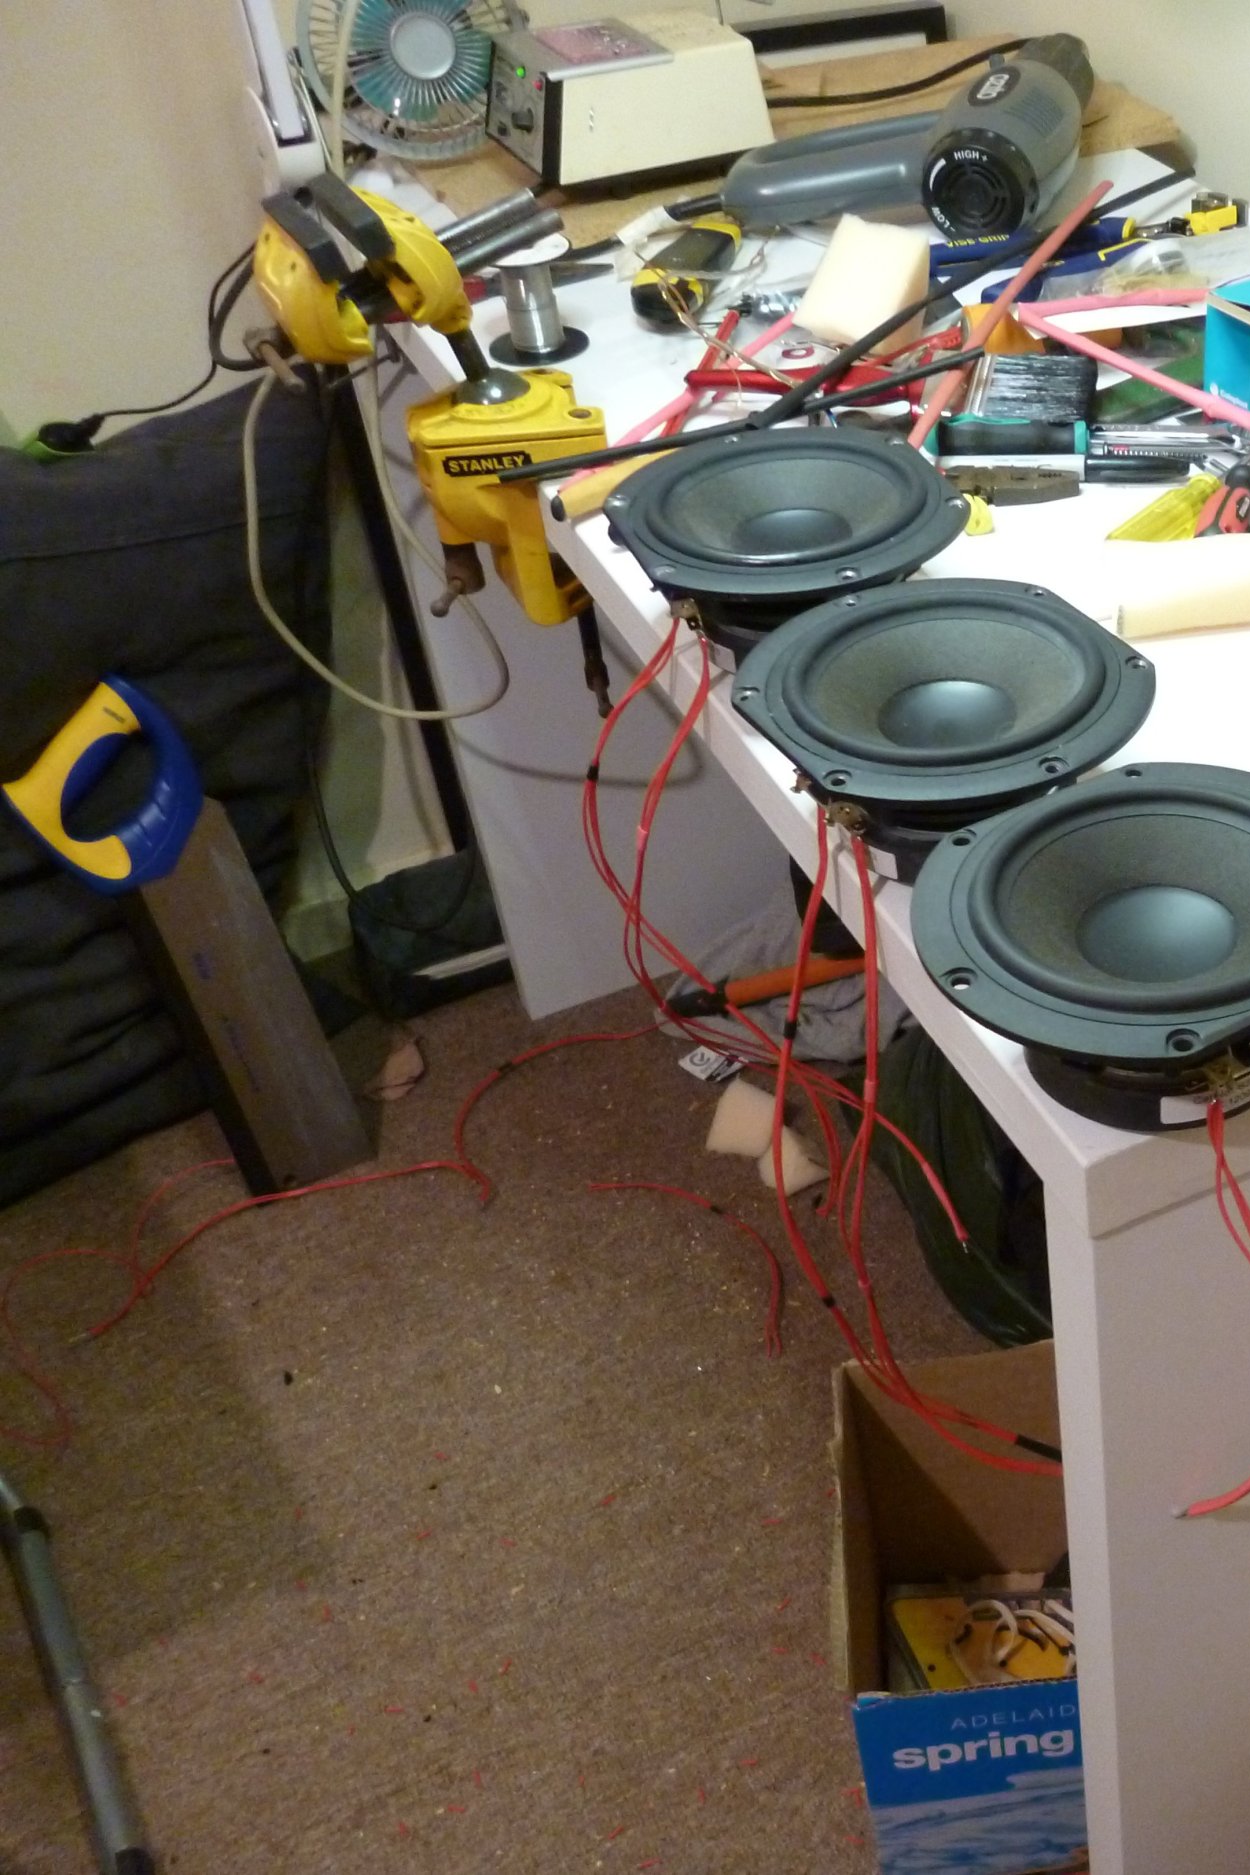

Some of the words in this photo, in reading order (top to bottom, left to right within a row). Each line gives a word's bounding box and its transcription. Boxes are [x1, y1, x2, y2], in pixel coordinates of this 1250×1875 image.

[953, 149, 980, 161] HIGH
[931, 206, 951, 229] LOW
[448, 455, 524, 473] STANLEY
[951, 1703, 1077, 1731] ADELAID
[892, 1729, 1075, 1772] spring
